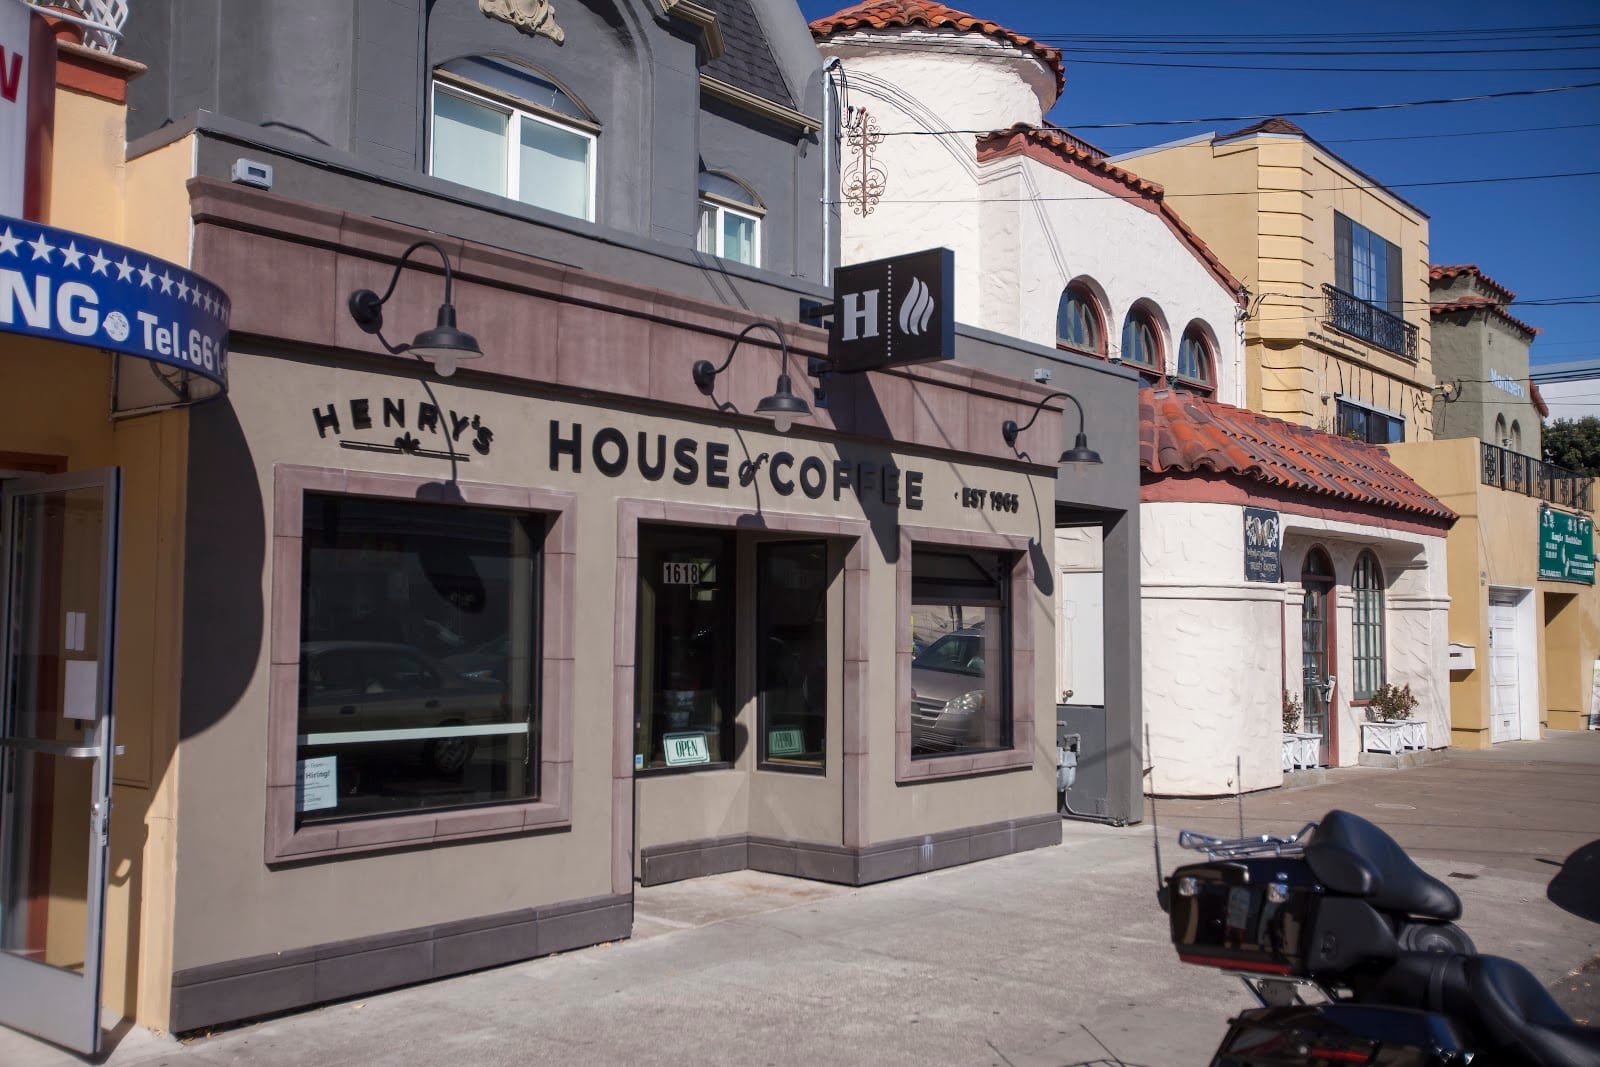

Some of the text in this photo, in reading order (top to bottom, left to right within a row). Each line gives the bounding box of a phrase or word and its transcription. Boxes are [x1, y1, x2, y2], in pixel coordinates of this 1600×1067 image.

[842, 289, 879, 341] H
[312, 398, 493, 455] HENRY'S
[549, 419, 923, 510] HOUSE of COFFEE
[990, 491, 1019, 514] 1965
[665, 563, 698, 583] 1618
[675, 739, 698, 758] OPEN
